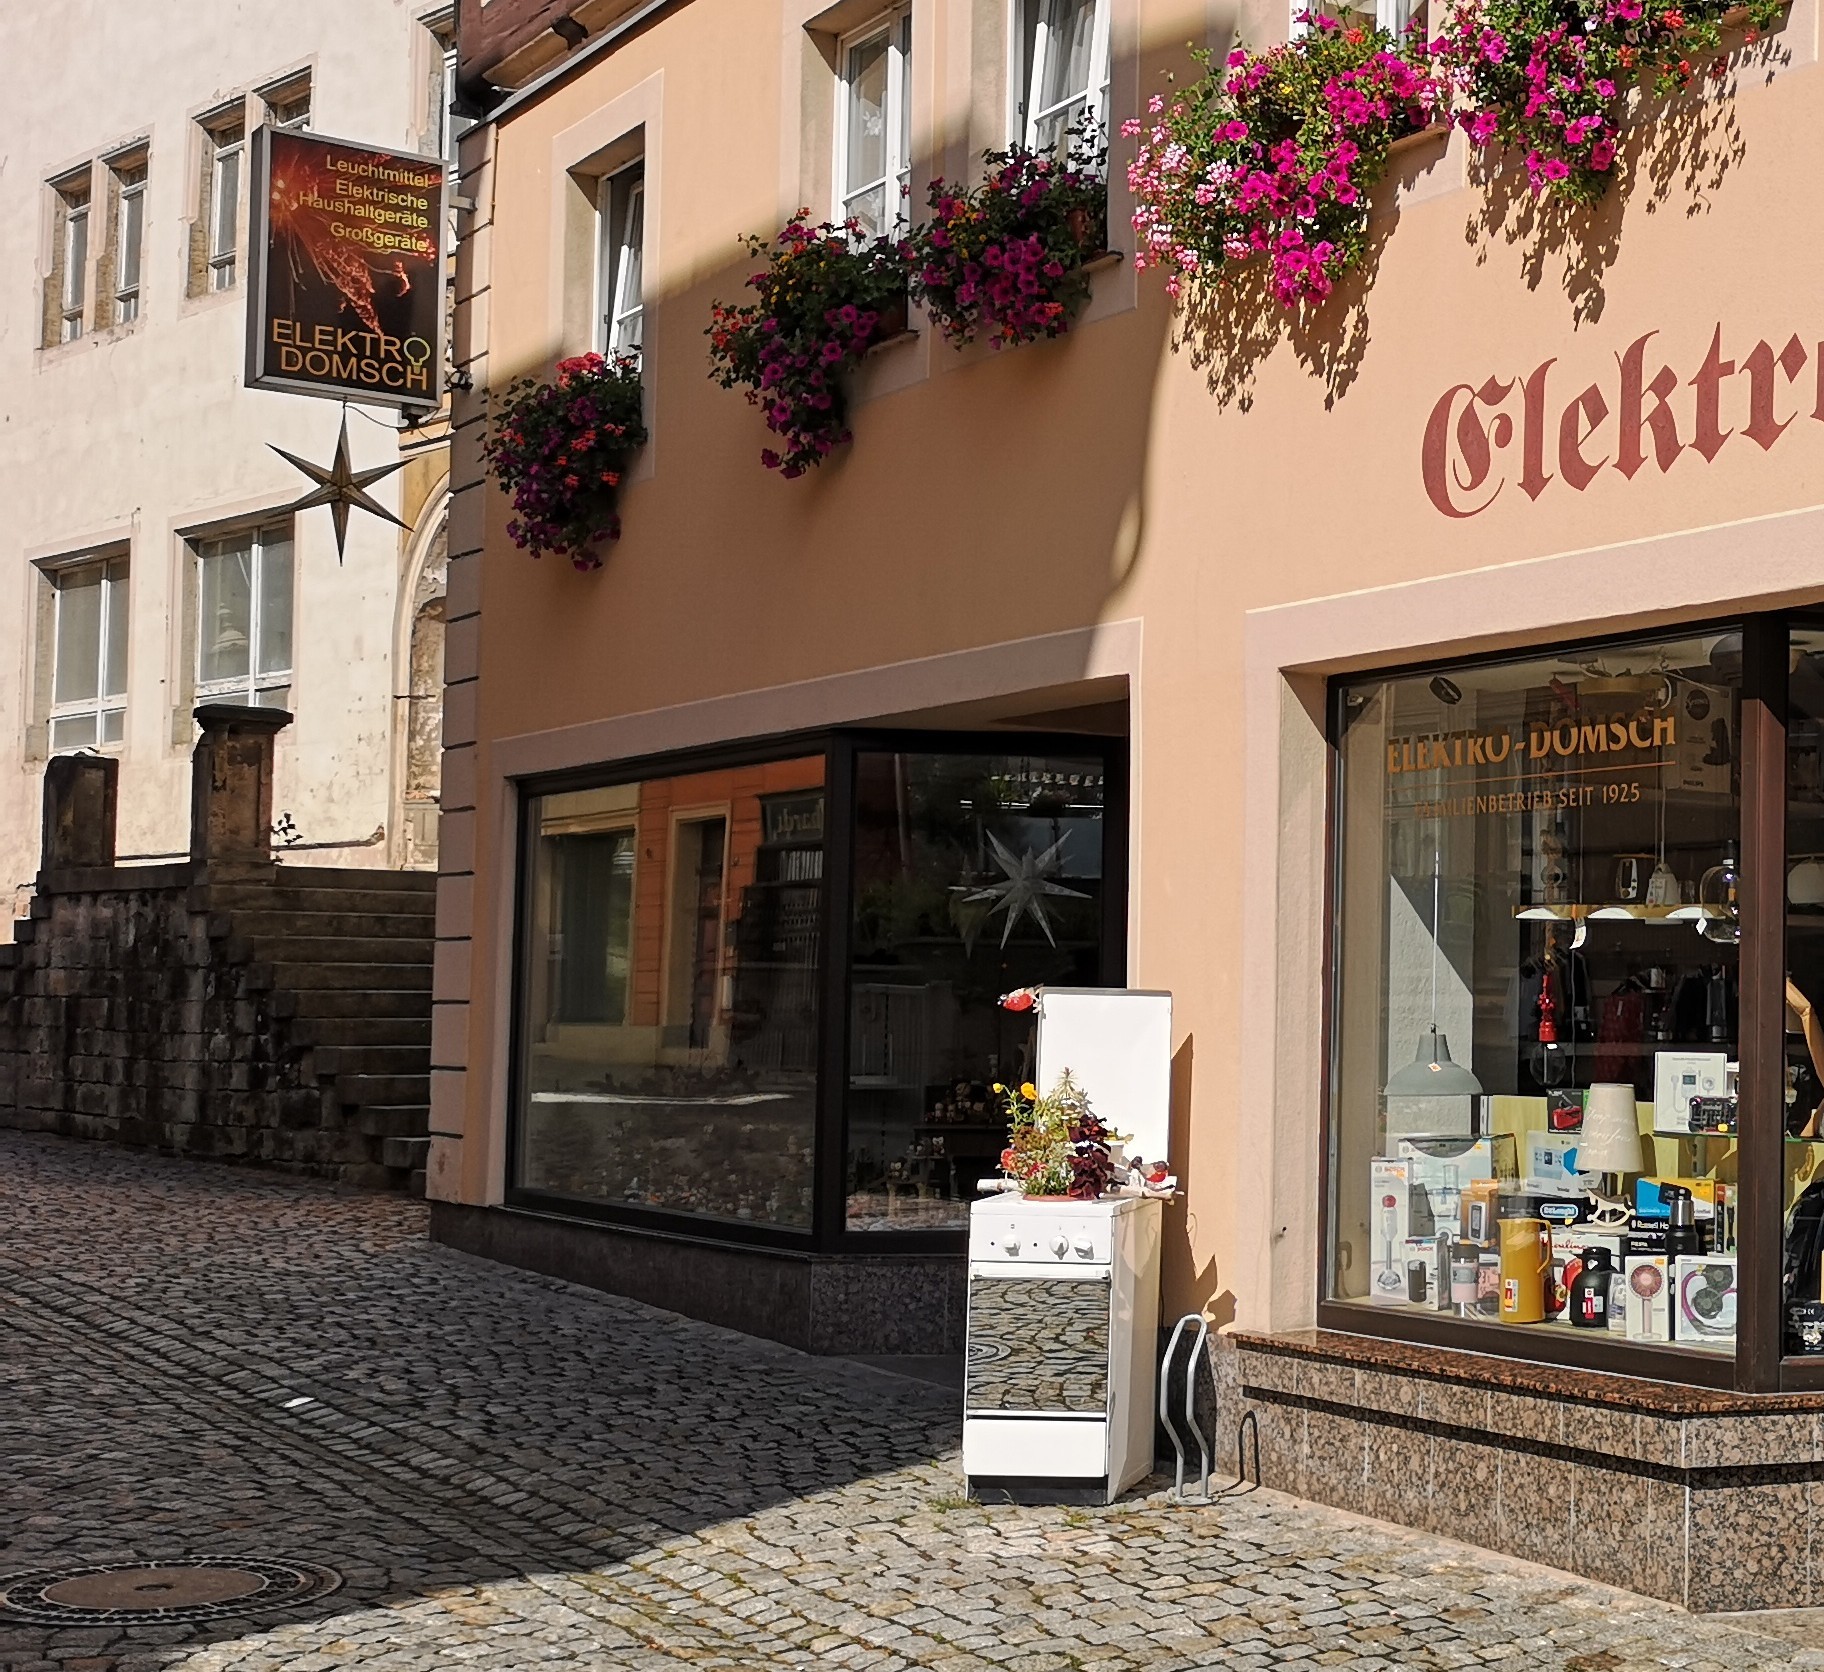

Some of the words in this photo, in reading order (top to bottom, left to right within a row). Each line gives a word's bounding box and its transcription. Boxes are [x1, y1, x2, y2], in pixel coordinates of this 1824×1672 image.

[326, 154, 429, 187] Leuchtmittel
[299, 191, 428, 228] Haushaltgeräte
[336, 179, 428, 209] Elektrische
[330, 222, 428, 251] Großgeräte
[273, 318, 431, 374] ELEKTRO
[280, 346, 427, 390] DOMSCH
[1414, 790, 1552, 819] FAMILIENBETRIEB
[1559, 786, 1594, 808] SEIT
[1602, 782, 1641, 804] 1925
